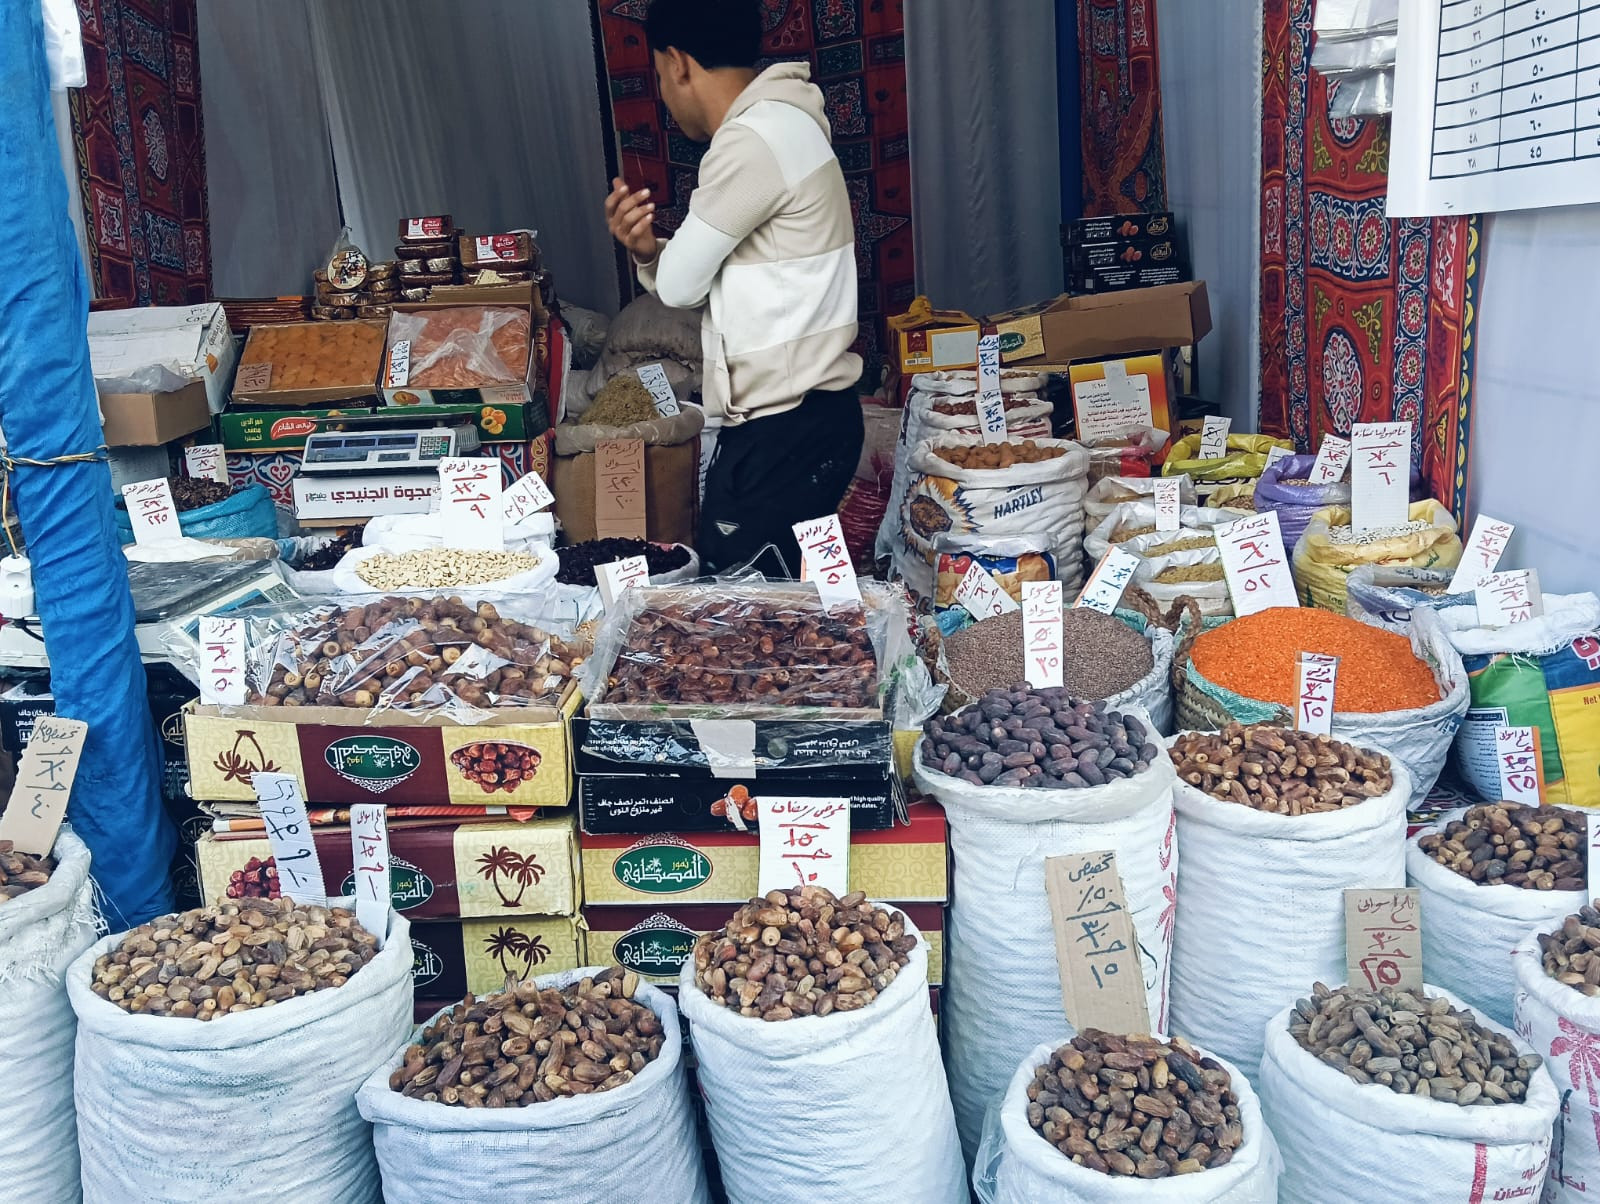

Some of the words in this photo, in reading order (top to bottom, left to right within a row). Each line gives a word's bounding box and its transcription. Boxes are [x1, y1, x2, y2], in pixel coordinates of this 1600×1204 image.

[1535, 8, 1546, 20] ٤٠
[1531, 35, 1548, 49] ١٢٠
[1532, 63, 1544, 76] ٥٠
[1530, 91, 1543, 104] ٨٠
[1469, 108, 1478, 118] ٧٠
[1529, 119, 1542, 131] ٦٠
[1469, 133, 1478, 144] ٤٨
[1529, 145, 1543, 159] ٤٥
[1320, 465, 1335, 480] ٩٥
[1378, 472, 1396, 486] ٦٠
[331, 487, 388, 504] الجنيدي
[394, 485, 431, 501] عجوة
[994, 485, 1043, 520] HARTLEY
[1244, 573, 1271, 592] ٥٢
[1510, 610, 1529, 624] ٤٨
[1035, 656, 1059, 678] ٣٥
[1583, 695, 1597, 706] Net
[1303, 701, 1324, 724] ٢٥
[329, 744, 414, 770] المصطفى
[347, 755, 364, 767] تمور
[1507, 774, 1536, 793] ٢٥
[597, 800, 616, 808] جاف
[617, 799, 634, 807] نصف
[634, 798, 648, 807] تمر
[854, 795, 867, 803] high
[867, 795, 887, 803] quality
[626, 807, 647, 817] منزوع
[647, 806, 663, 815] غير
[771, 800, 816, 822] رمضان
[813, 801, 847, 819] عرض
[621, 853, 706, 884] المصطفى
[672, 857, 689, 871] تمور
[1069, 853, 1114, 882] تخفيض
[286, 867, 308, 888] ١٠
[792, 861, 818, 888] ١٠
[396, 877, 413, 891] تمور
[671, 941, 689, 954] تمور
[1090, 962, 1118, 989] ١٥
[1359, 957, 1402, 992] ٢٥
[1493, 1184, 1537, 1201] رمضان
